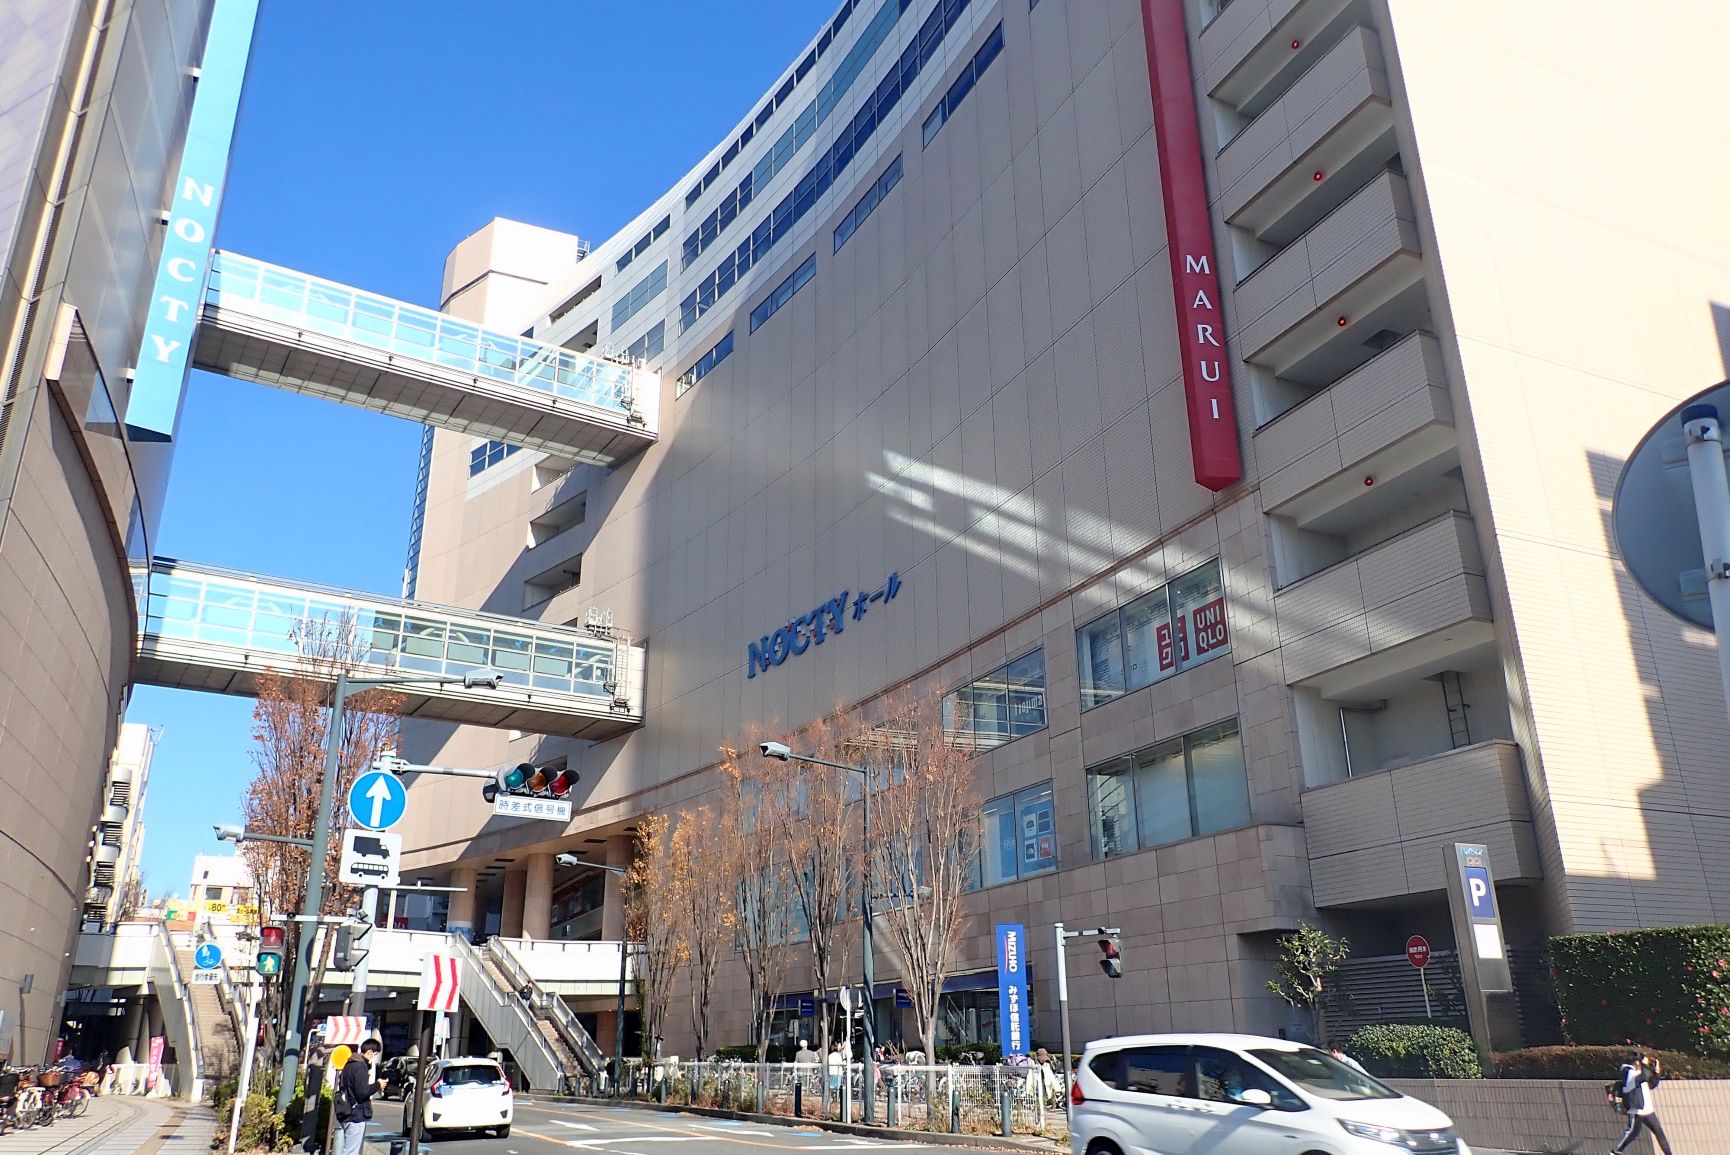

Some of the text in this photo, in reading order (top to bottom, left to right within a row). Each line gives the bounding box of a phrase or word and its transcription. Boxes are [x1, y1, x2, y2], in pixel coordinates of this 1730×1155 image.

[152, 175, 215, 363] NOCTY
[1185, 254, 1221, 419] MARUI
[498, 799, 567, 817] 時差式信号機
[1469, 877, 1487, 907] P
[1007, 931, 1018, 973] MIZUHO
[1008, 985, 1021, 1051] みずほ信託銀行
